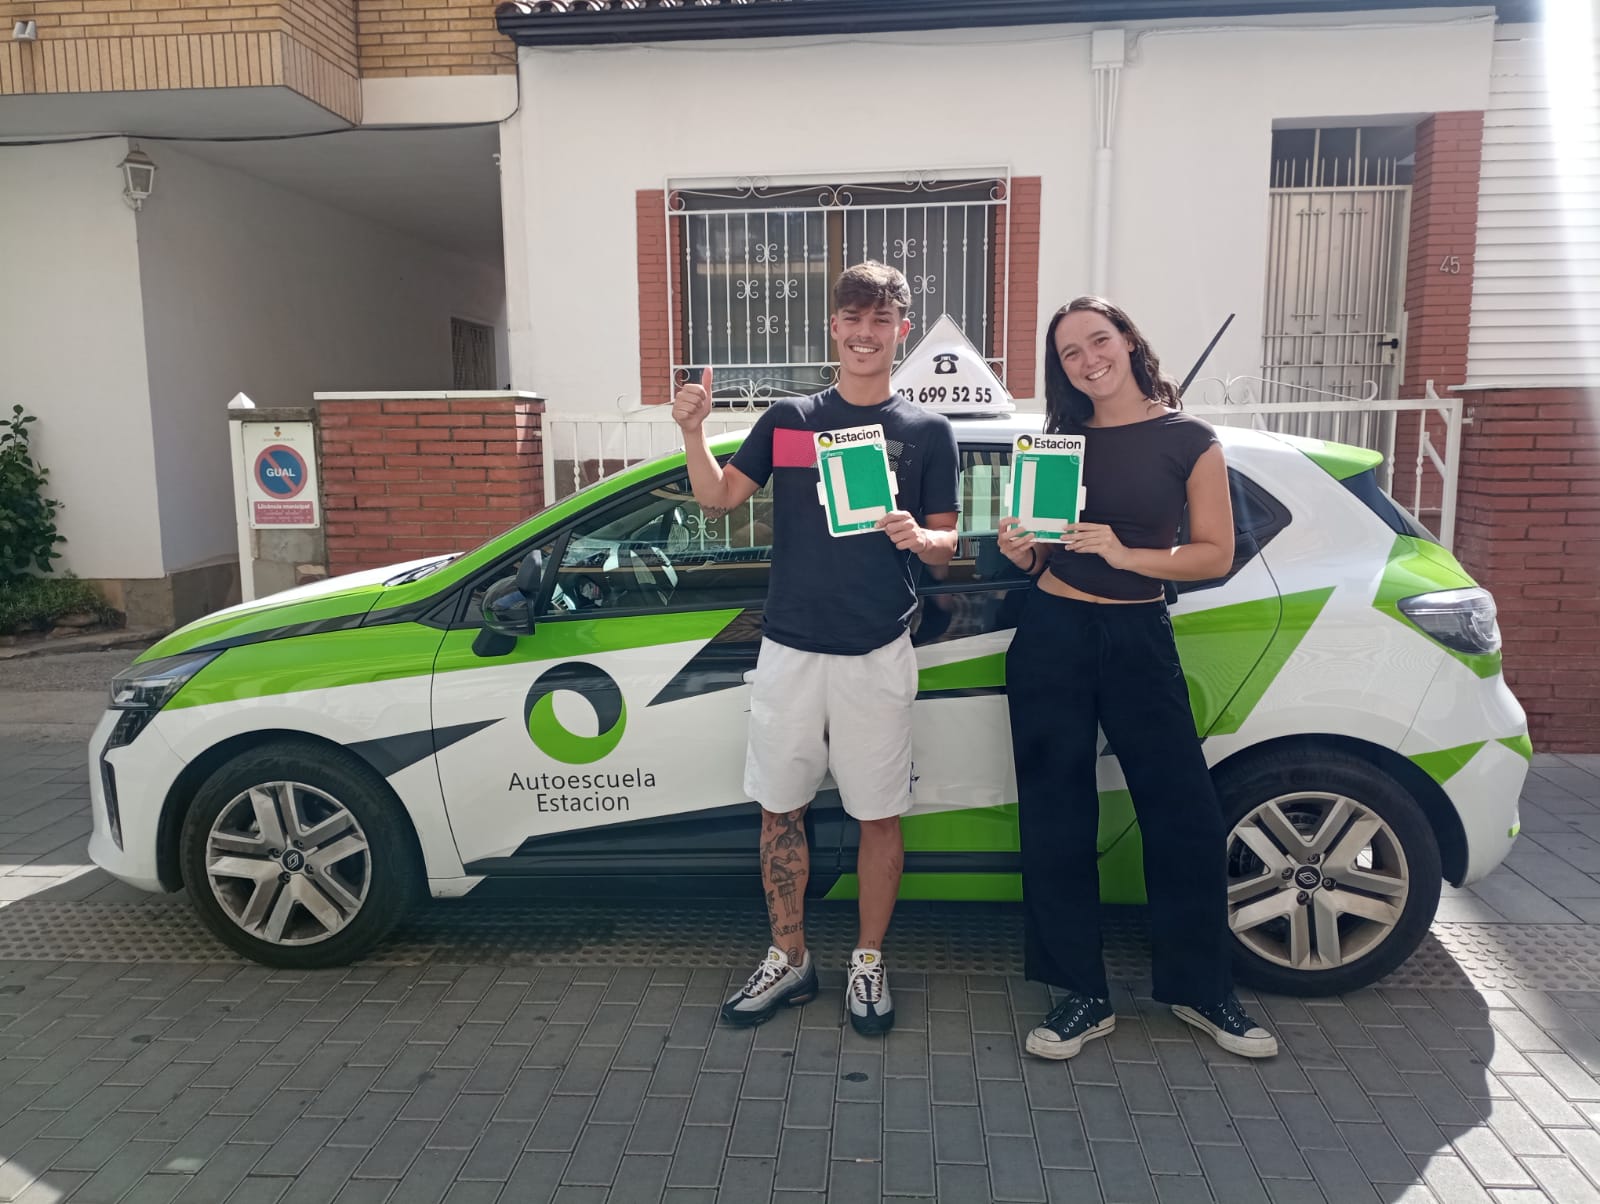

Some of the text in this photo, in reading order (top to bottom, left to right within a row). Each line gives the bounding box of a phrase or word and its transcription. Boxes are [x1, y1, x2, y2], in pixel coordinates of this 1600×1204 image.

[1440, 255, 1460, 274] 45
[918, 386, 947, 403] 699
[951, 386, 970, 402] 52
[975, 387, 992, 403] 55
[834, 429, 881, 444] Estacion
[1034, 437, 1082, 449] Estacion
[266, 468, 296, 477] GUAL
[508, 767, 656, 791] Autoescuela
[537, 791, 630, 812] Estacion
